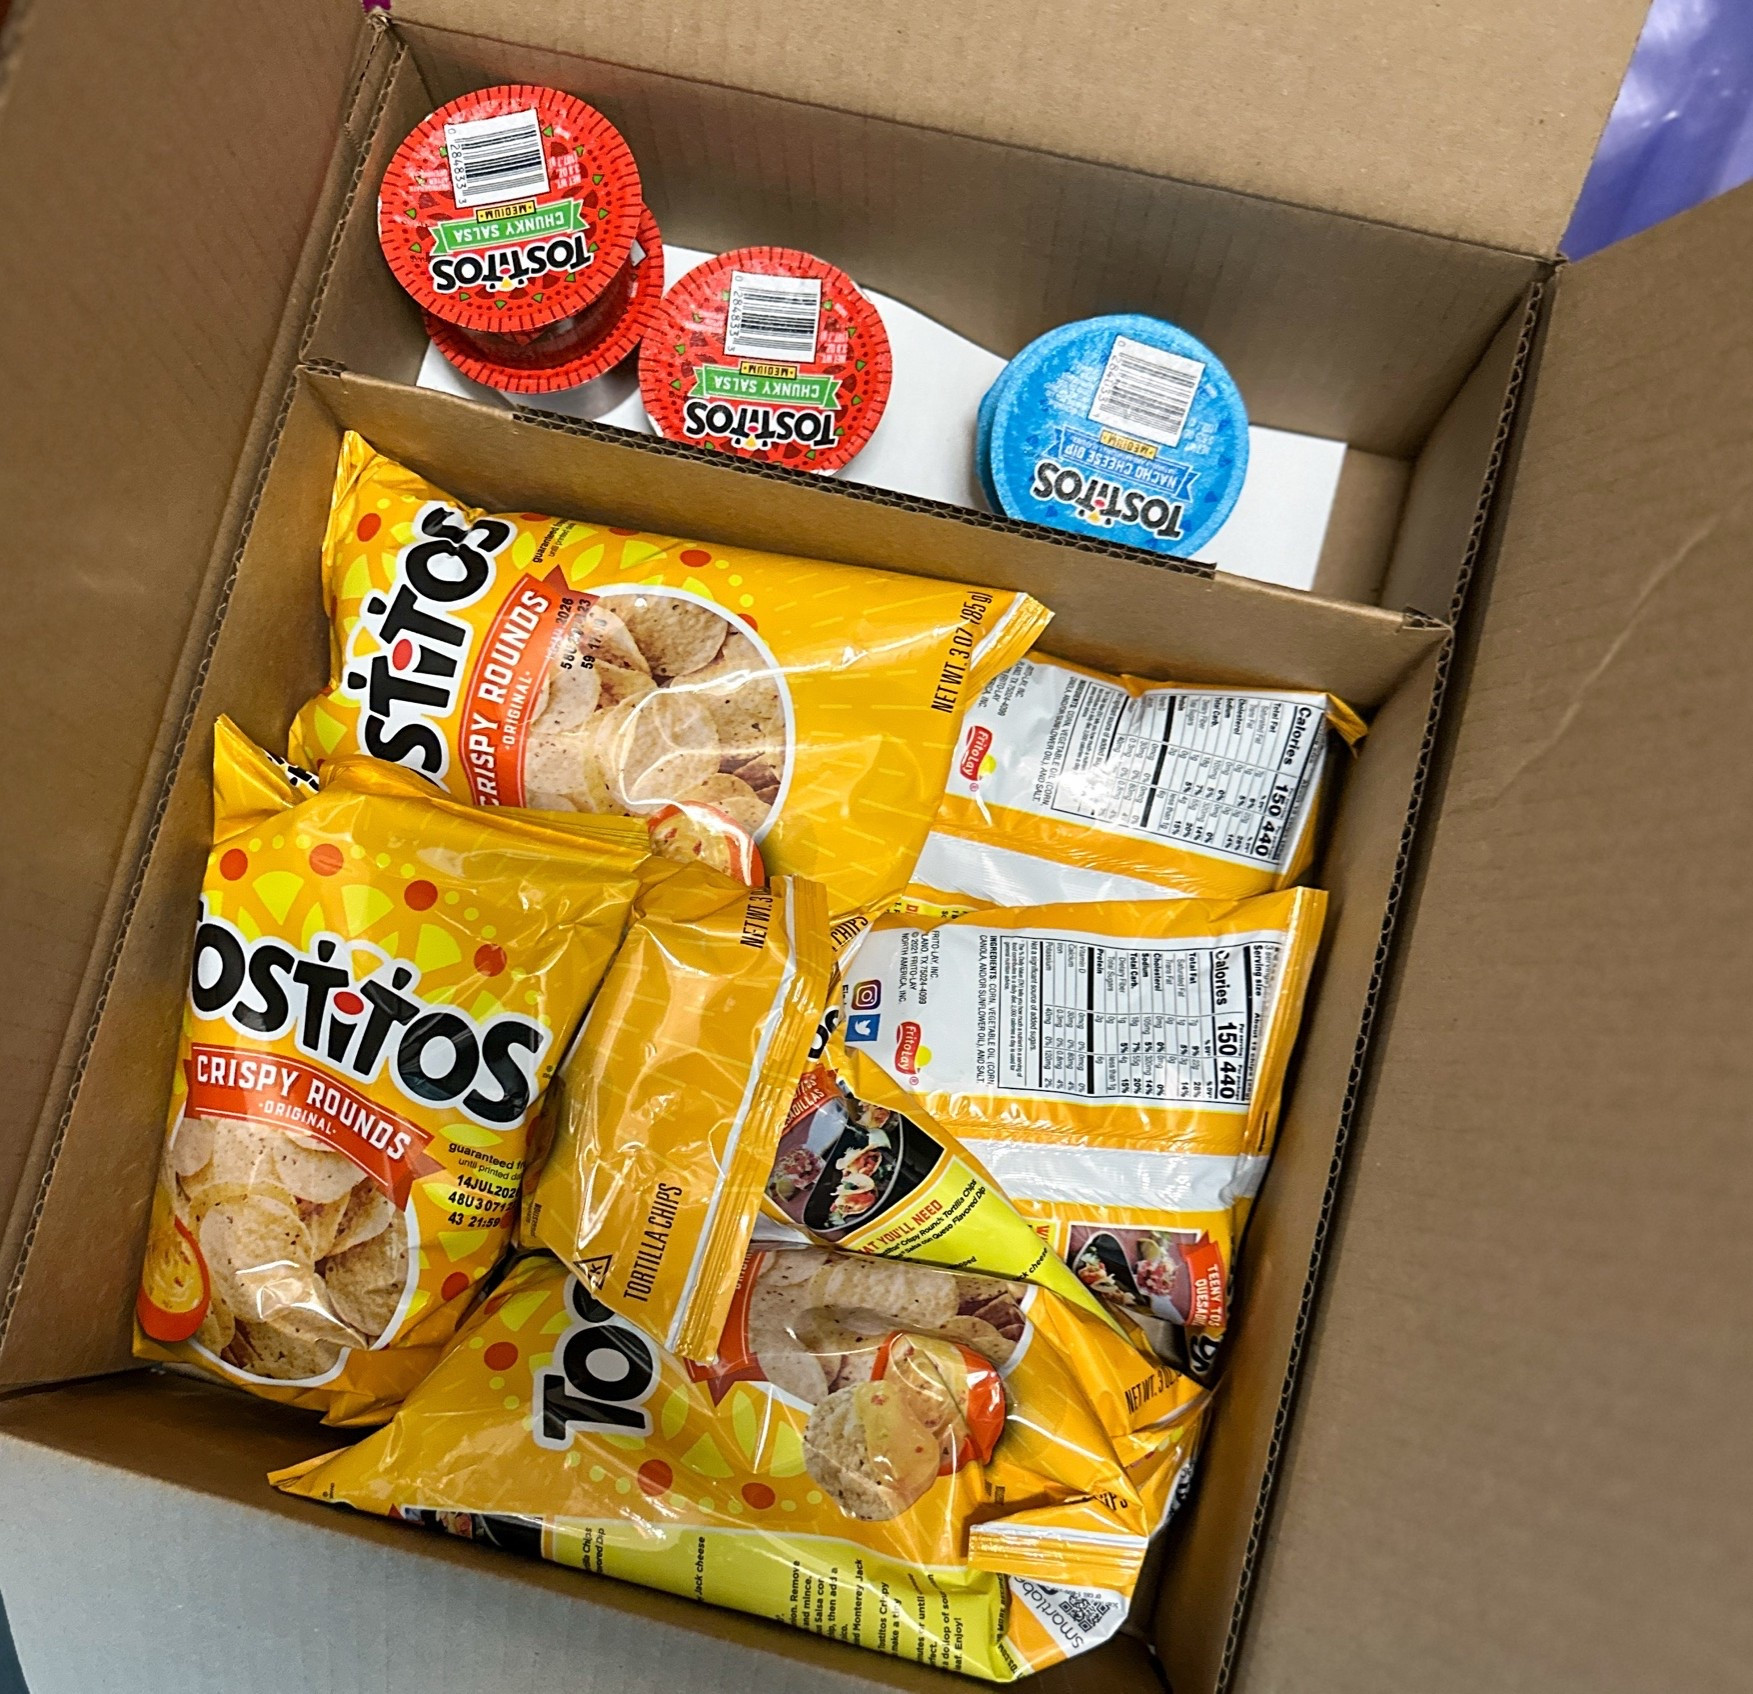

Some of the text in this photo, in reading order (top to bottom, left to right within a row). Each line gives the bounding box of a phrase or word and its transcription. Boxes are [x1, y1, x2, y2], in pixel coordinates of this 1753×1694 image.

[453, 210, 565, 243] CHUNKY SALSA
[485, 203, 528, 220] MEDIUM
[713, 374, 821, 399] CHUNKY SALSA
[747, 363, 790, 377] MEDIUM
[1063, 443, 1087, 460] DIP
[1088, 450, 1134, 476] CHEESE
[1134, 466, 1178, 490] NACHO
[532, 526, 558, 564] guaranteed
[478, 588, 550, 706] ROUNDS
[580, 654, 596, 670] 59
[949, 647, 971, 660] 3
[939, 660, 969, 687] WT.
[502, 673, 533, 747] ORIGINAL
[931, 684, 959, 714] NET
[1270, 703, 1282, 720] Total
[1232, 697, 1248, 736] Cholesterol
[1051, 728, 1069, 766] VEGETABLE
[1283, 706, 1312, 766] Calories
[1036, 767, 1048, 783] AND
[1254, 784, 1289, 857] 150 440
[740, 903, 774, 949] NET WT.
[900, 932, 910, 956] NORTH
[908, 955, 919, 991] FRITO-LAY
[1029, 955, 1038, 984] significant
[1096, 948, 1105, 974] Protein
[1129, 952, 1139, 970] Total
[1141, 952, 1150, 978] Sodium
[1153, 952, 1163, 992] Cholesterol
[1188, 952, 1197, 970] Total
[1252, 944, 1265, 996] Serving size
[918, 965, 929, 1005] 75024-4099
[1129, 971, 1140, 990] Carb.
[1189, 972, 1198, 985] Fat
[191, 921, 545, 1124] OSTITOS
[976, 989, 987, 1032] SUNFLOWER
[986, 1006, 997, 1047] VEGETABLE
[1214, 949, 1238, 1100] Calories 150 440
[976, 1049, 986, 1065] AND
[986, 1047, 996, 1060] OIL
[196, 1053, 413, 1162] CRISPY ROUNDS
[263, 1099, 334, 1136] ORIGINAL
[448, 1142, 514, 1169] guaranteed
[458, 1157, 478, 1169] until
[478, 1163, 510, 1180] printed
[447, 1211, 502, 1229] 43 21:59
[877, 1199, 944, 1245] YOU'LL NEED
[899, 1232, 921, 1249] Crispy
[942, 1196, 966, 1219] Tortilla
[962, 1177, 979, 1200] Chips
[931, 1223, 954, 1241] Queso
[952, 1197, 978, 1226] Flavored
[974, 1185, 987, 1202] Dip
[622, 1182, 684, 1304] TORTILLA CHIPS
[1027, 1247, 1049, 1274] cheese
[1206, 1263, 1223, 1302] TEENY
[1124, 1383, 1142, 1416] NET
[693, 1535, 707, 1598] Jack cheese
[789, 1560, 801, 1602] Remove
[802, 1575, 813, 1610] mince.
[829, 1576, 838, 1597] add
[853, 1558, 865, 1633] Monterey Jack
[814, 1598, 824, 1622] Salsa
[827, 1599, 837, 1622] then
[916, 1594, 926, 1620] until
[878, 1617, 888, 1650] Tostitos
[953, 1616, 964, 1651] Enjoy!
